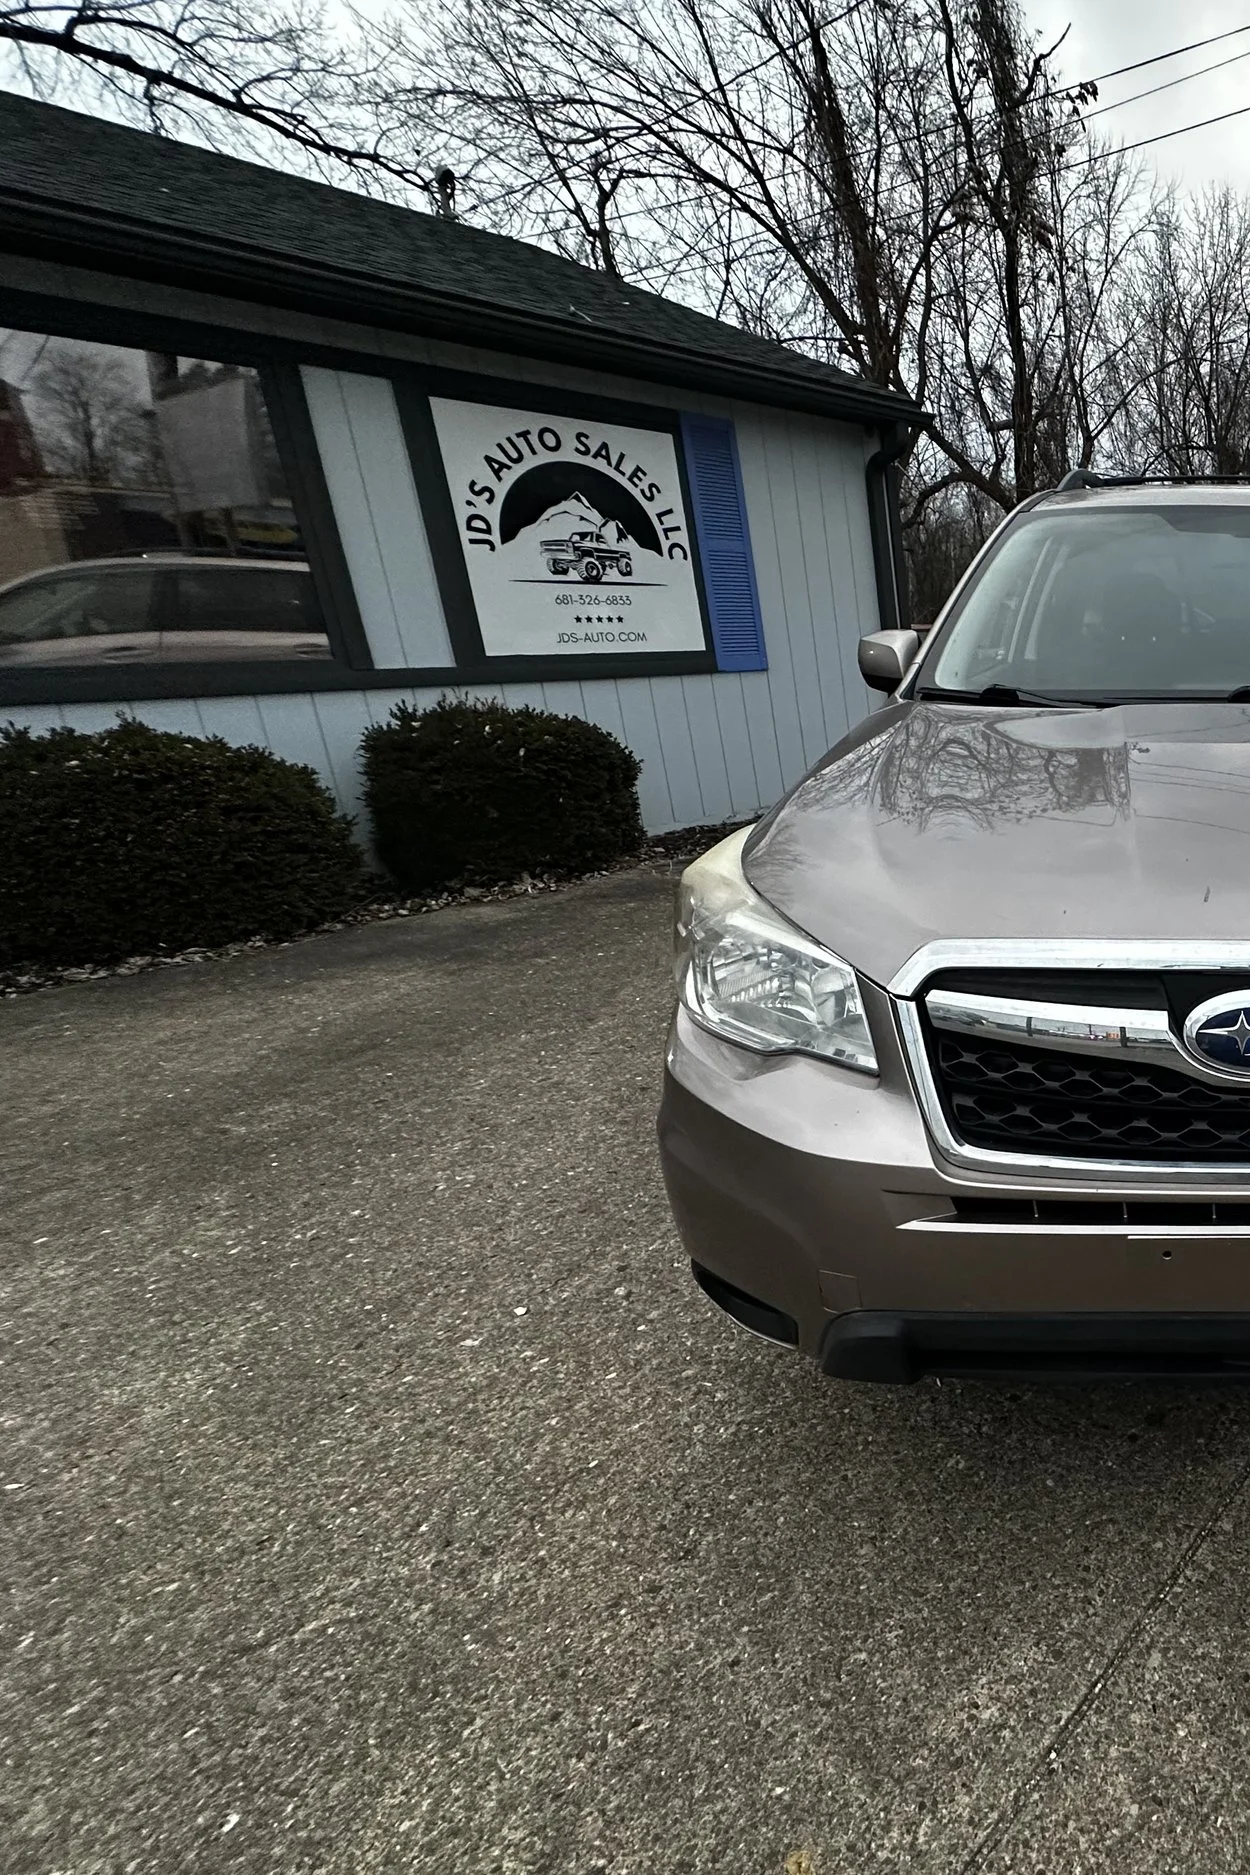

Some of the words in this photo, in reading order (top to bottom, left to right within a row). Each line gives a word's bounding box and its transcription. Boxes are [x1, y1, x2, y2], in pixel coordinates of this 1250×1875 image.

[465, 479, 496, 552] JD'S
[483, 426, 562, 482] AUTO
[574, 431, 661, 503] SALES
[656, 508, 688, 562] LLC
[554, 593, 632, 606] 681-326-6833
[556, 631, 648, 644] JDS-AUTO.COM
